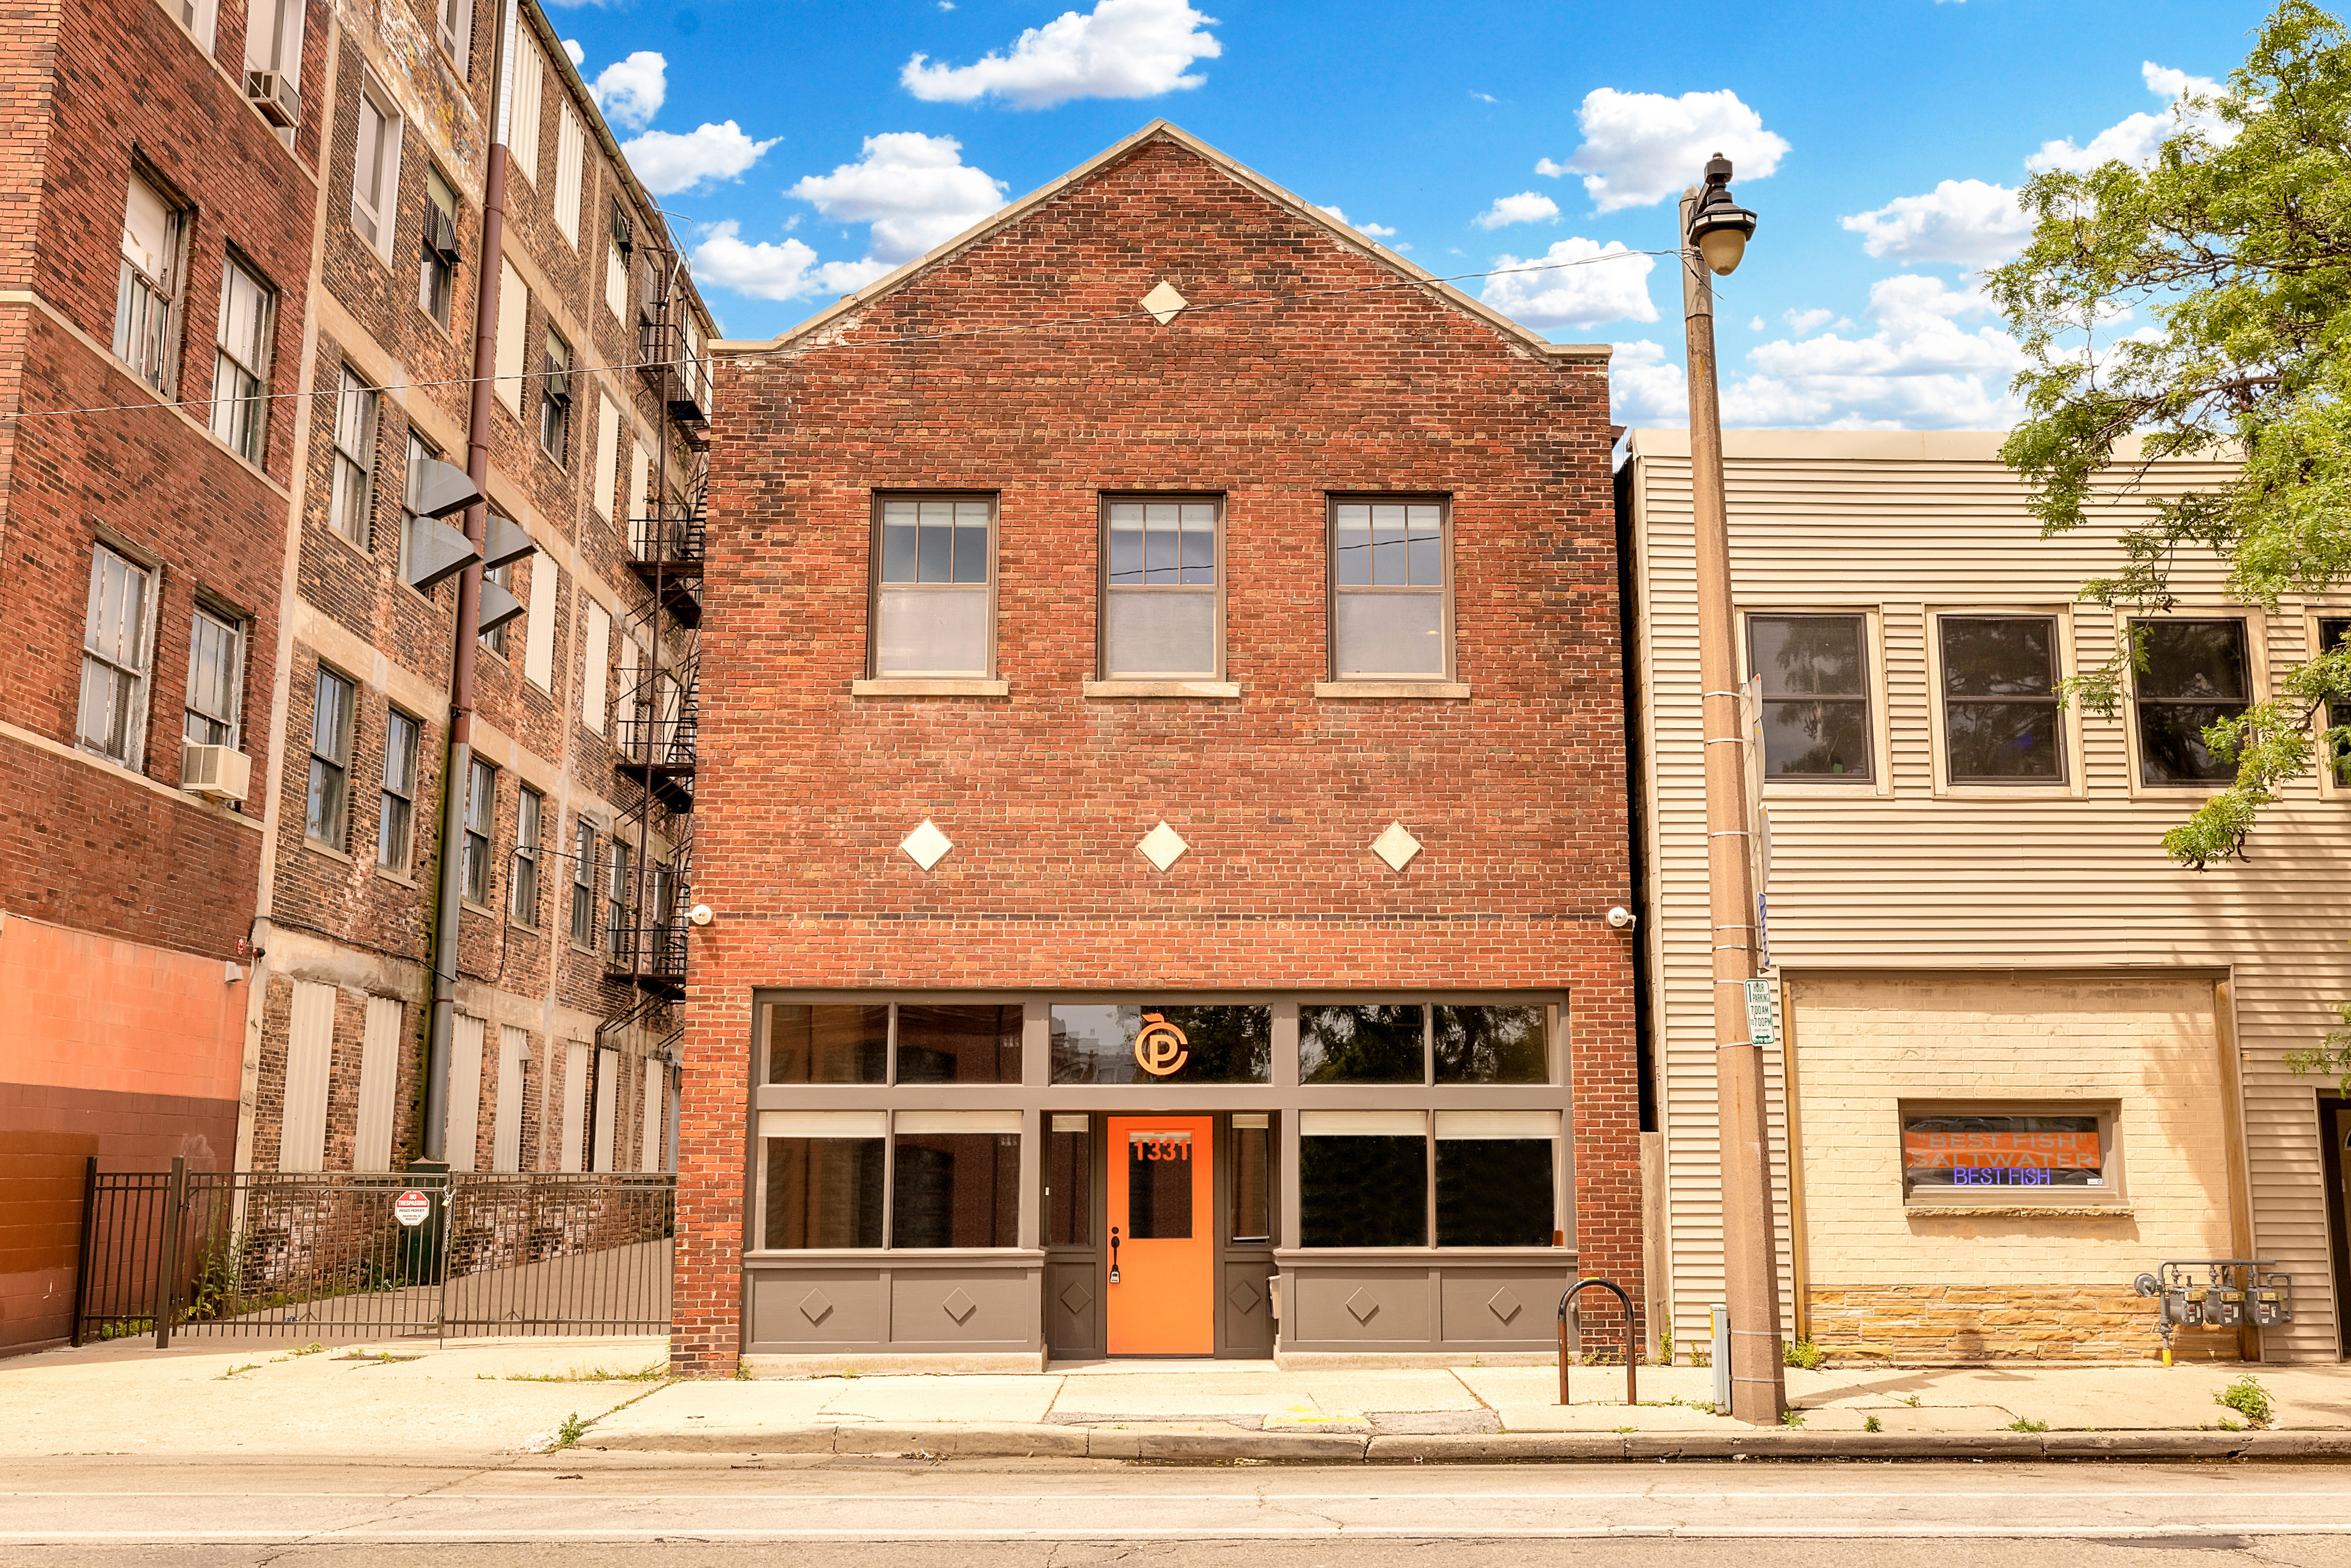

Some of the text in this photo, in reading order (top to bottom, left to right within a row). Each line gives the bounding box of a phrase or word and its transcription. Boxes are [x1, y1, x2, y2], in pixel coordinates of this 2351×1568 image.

[1747, 983, 1764, 1003] 1 HOUR
[1752, 993, 1769, 1003] PARKING
[1762, 1006, 1769, 1015] AM
[1918, 1133, 2087, 1148] "BEST FISH"
[1134, 1139, 1187, 1161] 1331
[1911, 1152, 2094, 1167] SALTWATER
[1954, 1167, 2051, 1185] BEST FISH
